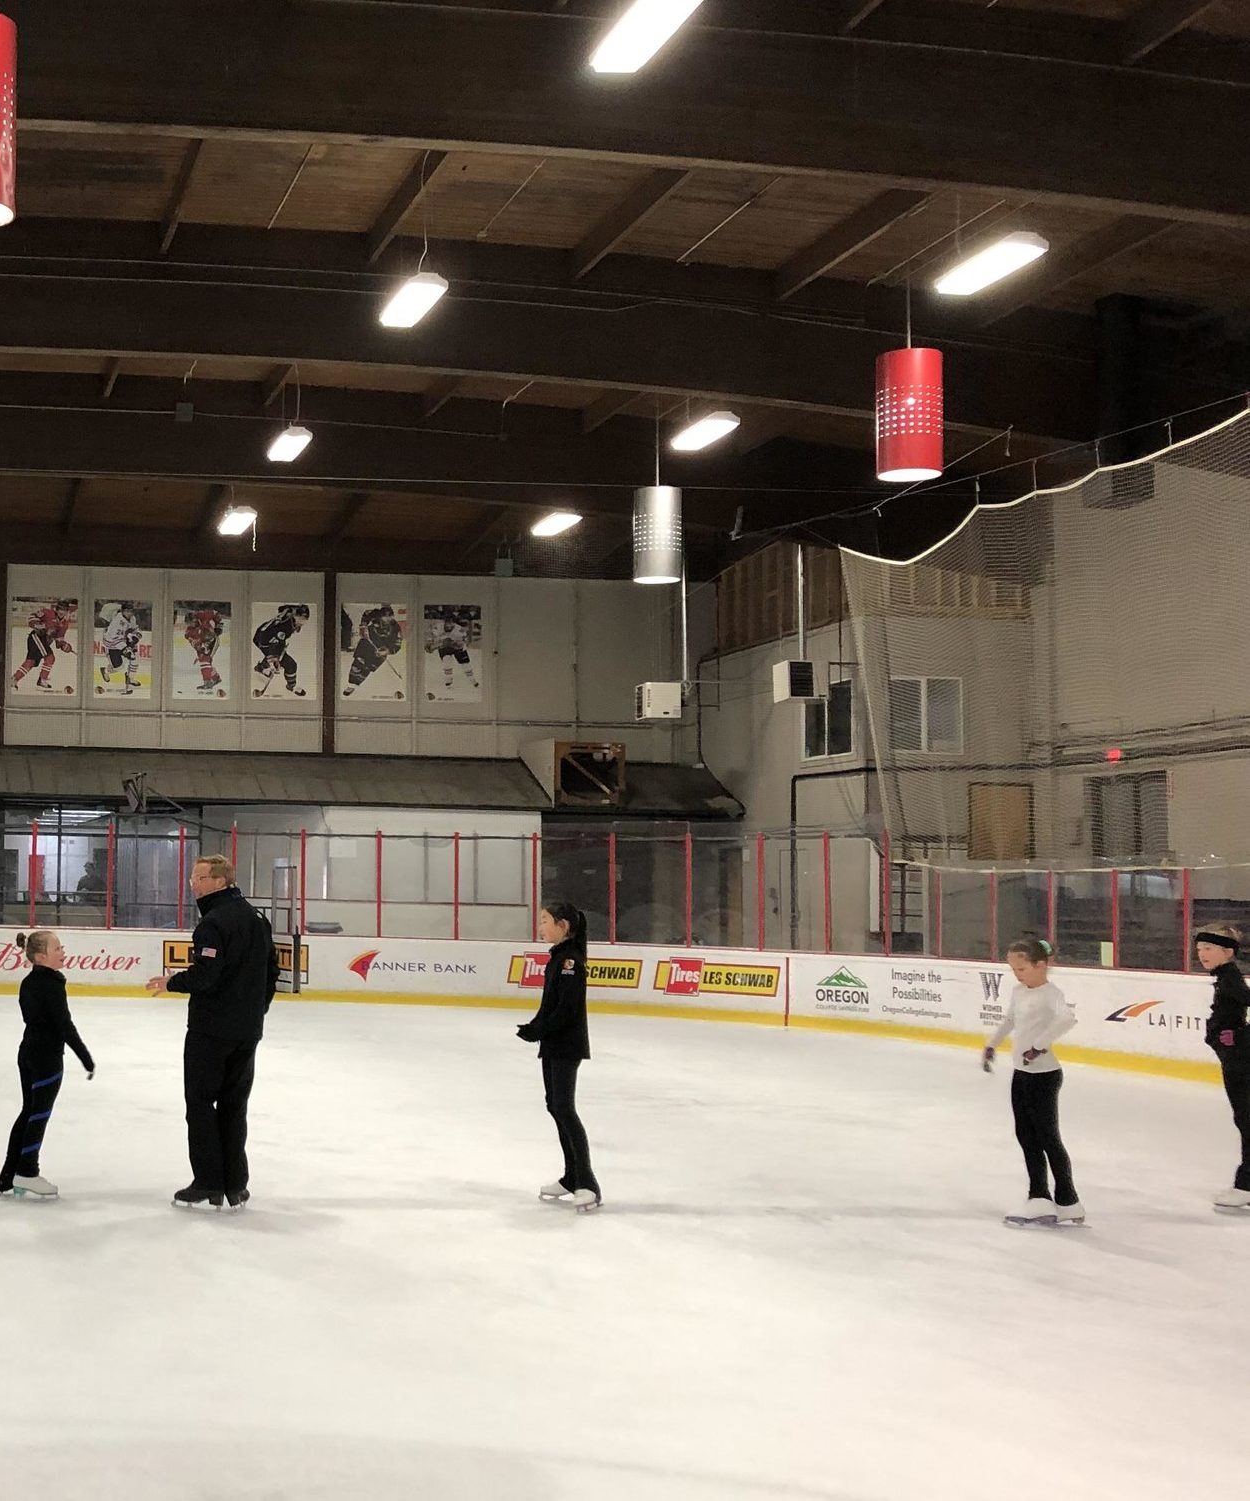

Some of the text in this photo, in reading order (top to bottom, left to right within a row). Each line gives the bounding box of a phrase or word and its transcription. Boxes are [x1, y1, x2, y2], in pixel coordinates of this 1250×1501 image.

[362, 960, 477, 974] BANNER BANK
[670, 962, 774, 988] Tires LES SCHWAB
[891, 967, 942, 985] Imagine the
[815, 988, 869, 1005] OREGON
[892, 986, 942, 1003] Possibilities
[1148, 1013, 1202, 1031] LA FIT
